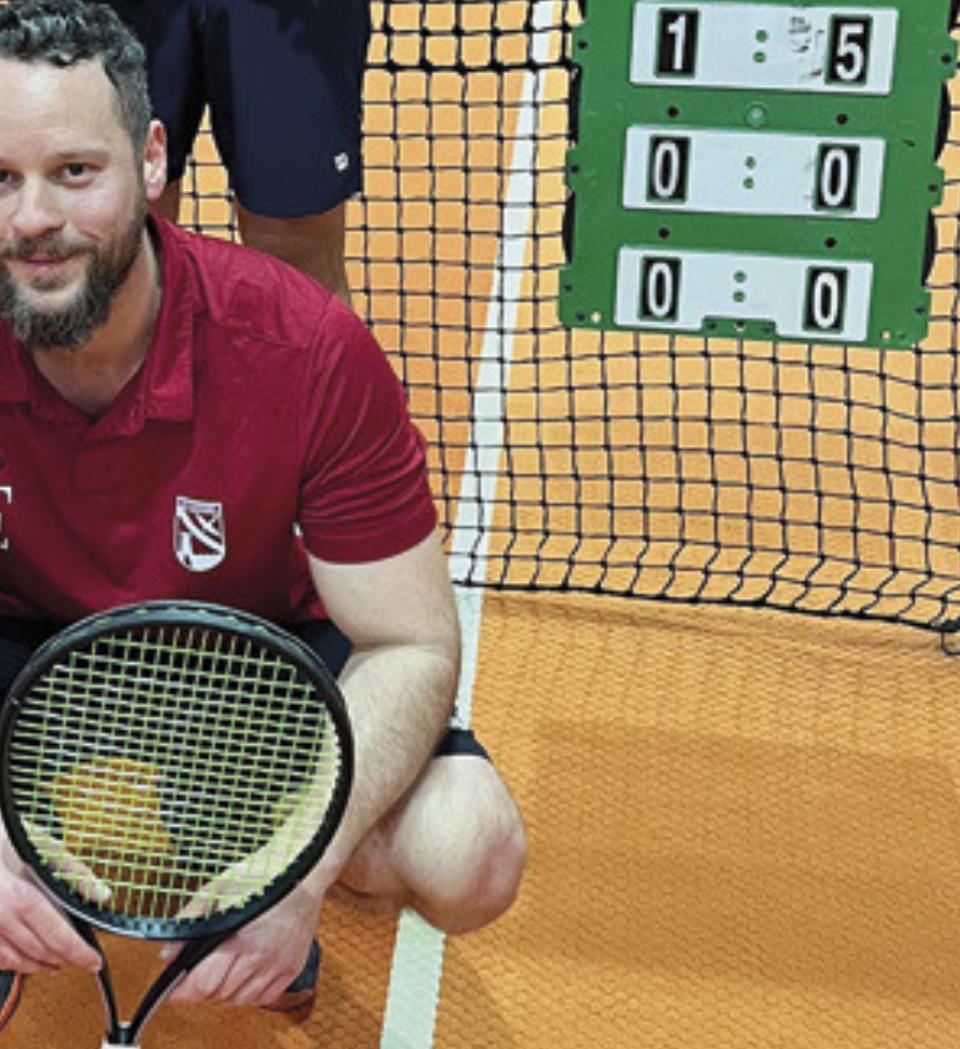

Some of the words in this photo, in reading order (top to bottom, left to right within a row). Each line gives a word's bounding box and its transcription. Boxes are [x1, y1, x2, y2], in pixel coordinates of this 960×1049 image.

[667, 14, 687, 71] 1
[836, 23, 864, 81] 5
[653, 141, 680, 198] 0
[821, 149, 849, 207] 0
[648, 262, 673, 318] 0
[813, 271, 839, 330] 0
